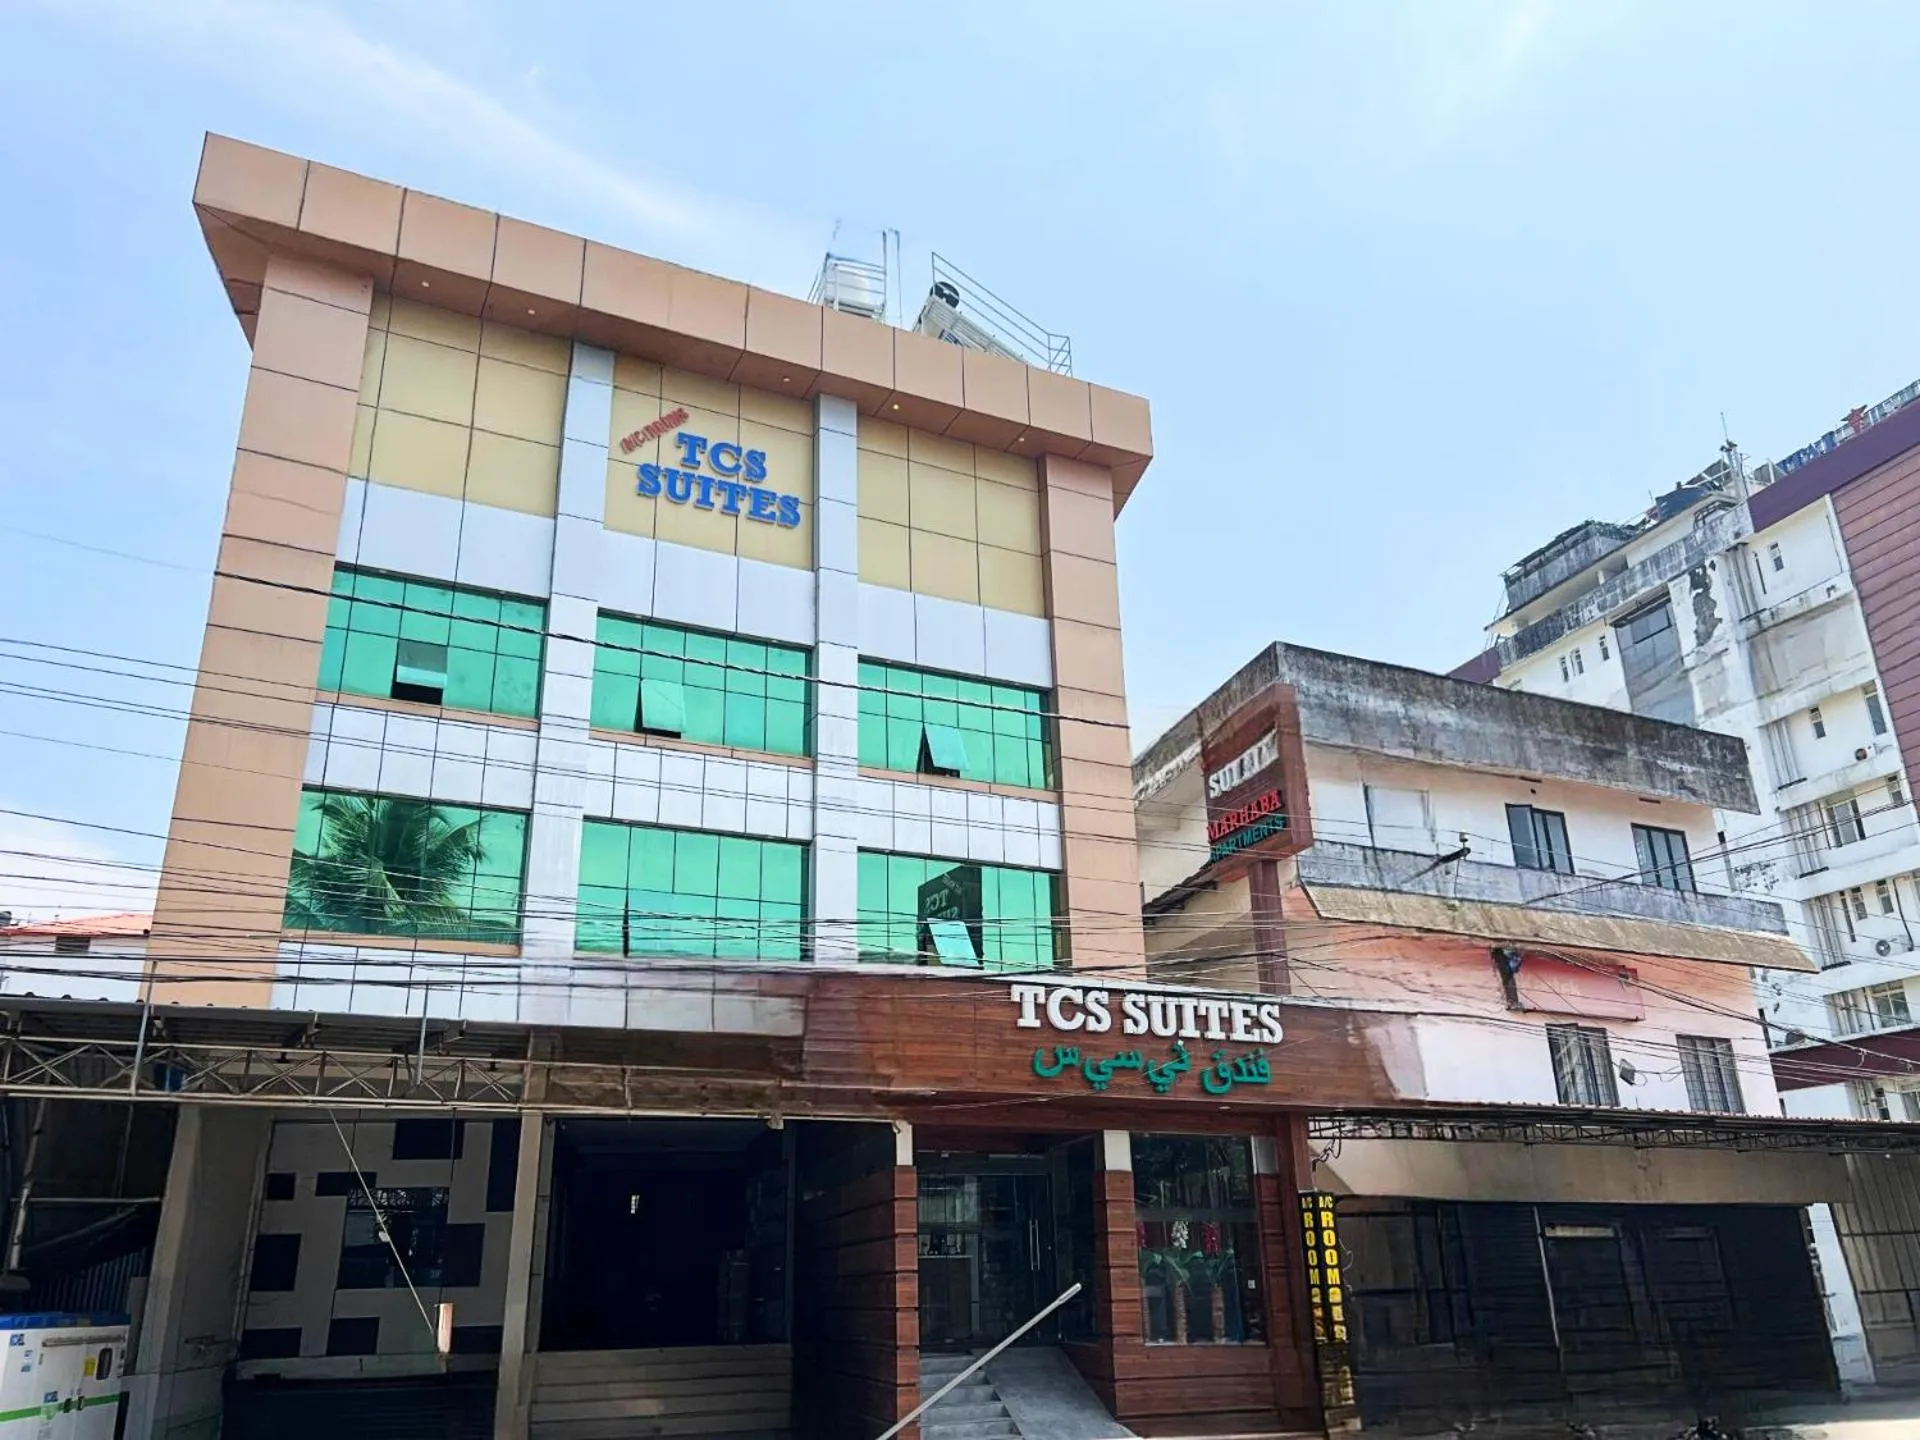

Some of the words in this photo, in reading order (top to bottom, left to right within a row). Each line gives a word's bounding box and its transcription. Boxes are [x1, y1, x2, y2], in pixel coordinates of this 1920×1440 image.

[674, 432, 768, 483] TCS
[636, 463, 801, 529] SUITES
[1207, 788, 1281, 841] MARHABA
[1010, 983, 1112, 1032] TCS
[1122, 992, 1284, 1044] SUITES
[1032, 1045, 1080, 1078] س
[1084, 1048, 1142, 1091] سي
[1200, 1047, 1272, 1095] فندق
[1318, 1195, 1334, 1208] A/C
